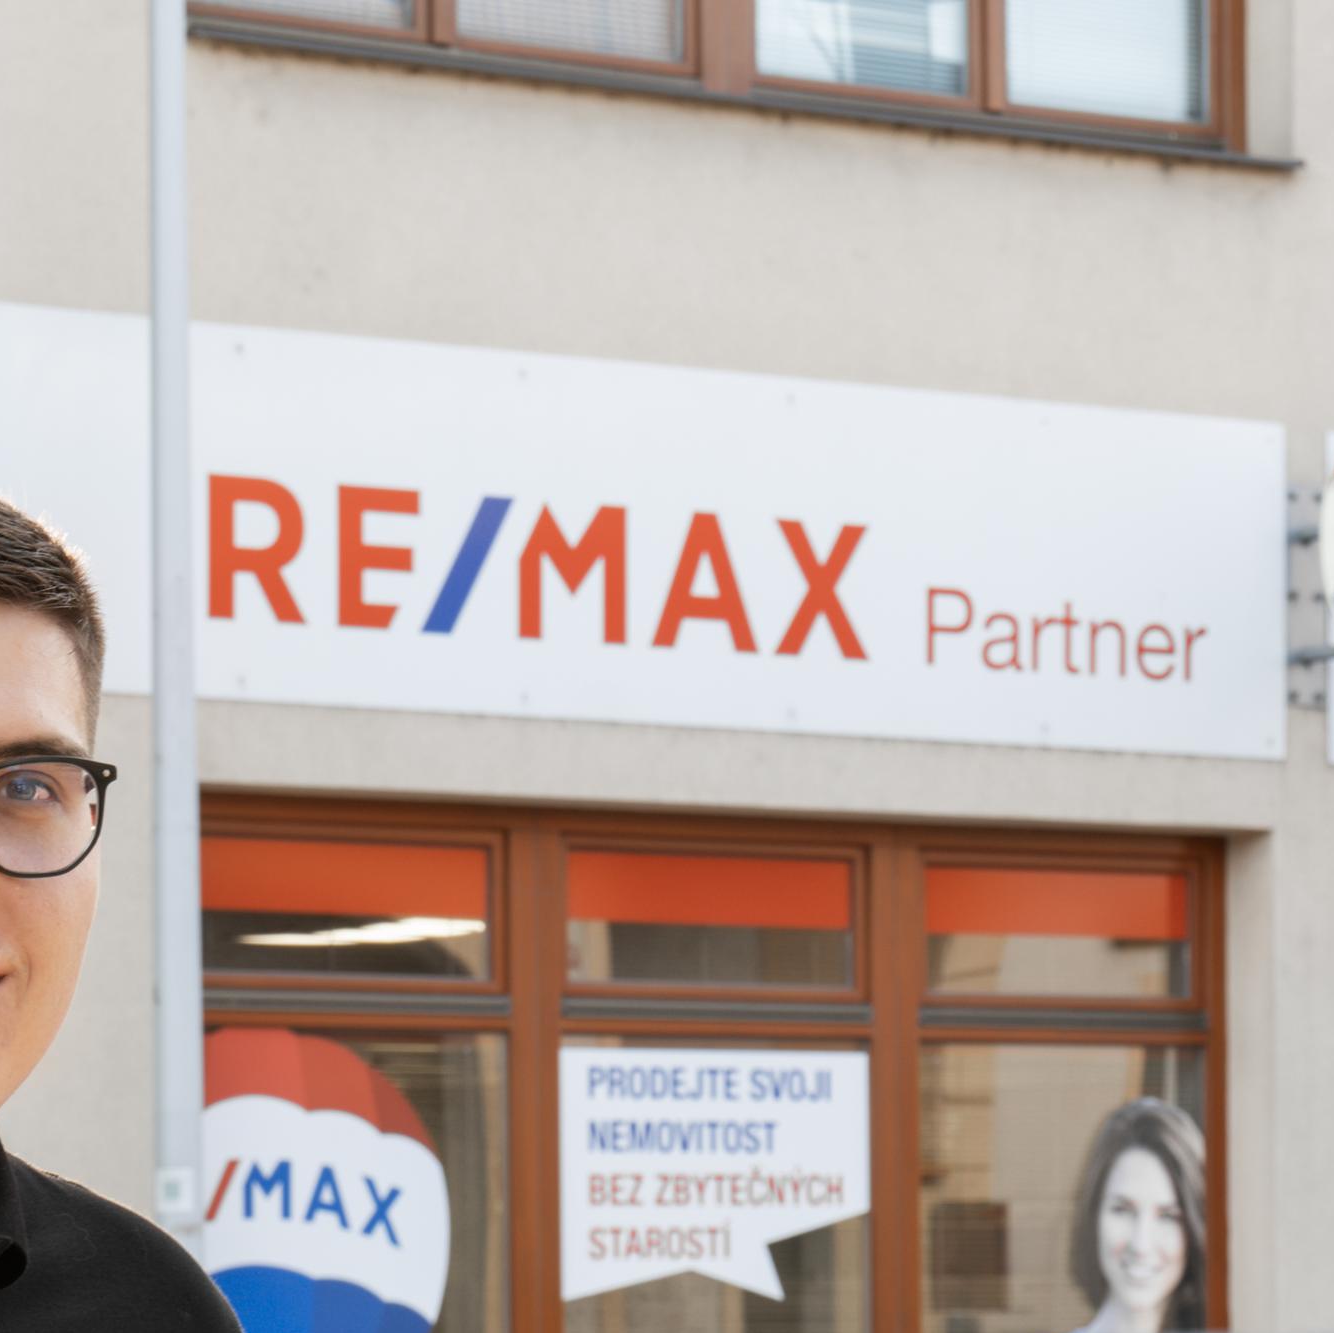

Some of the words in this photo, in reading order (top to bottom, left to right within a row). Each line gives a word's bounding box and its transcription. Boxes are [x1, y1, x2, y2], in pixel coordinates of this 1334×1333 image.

[207, 473, 869, 662] RE/MAX
[926, 587, 1208, 682] Partner
[588, 1066, 738, 1101] PRODEJTE
[749, 1069, 833, 1103] SVOJI
[588, 1120, 777, 1154] NEMOVITOST
[205, 1159, 402, 1247] /MAX
[589, 1174, 643, 1206] BEZ
[656, 1165, 845, 1206] ZBYTEČNÝCH
[589, 1218, 732, 1260] STAROSTÍ
